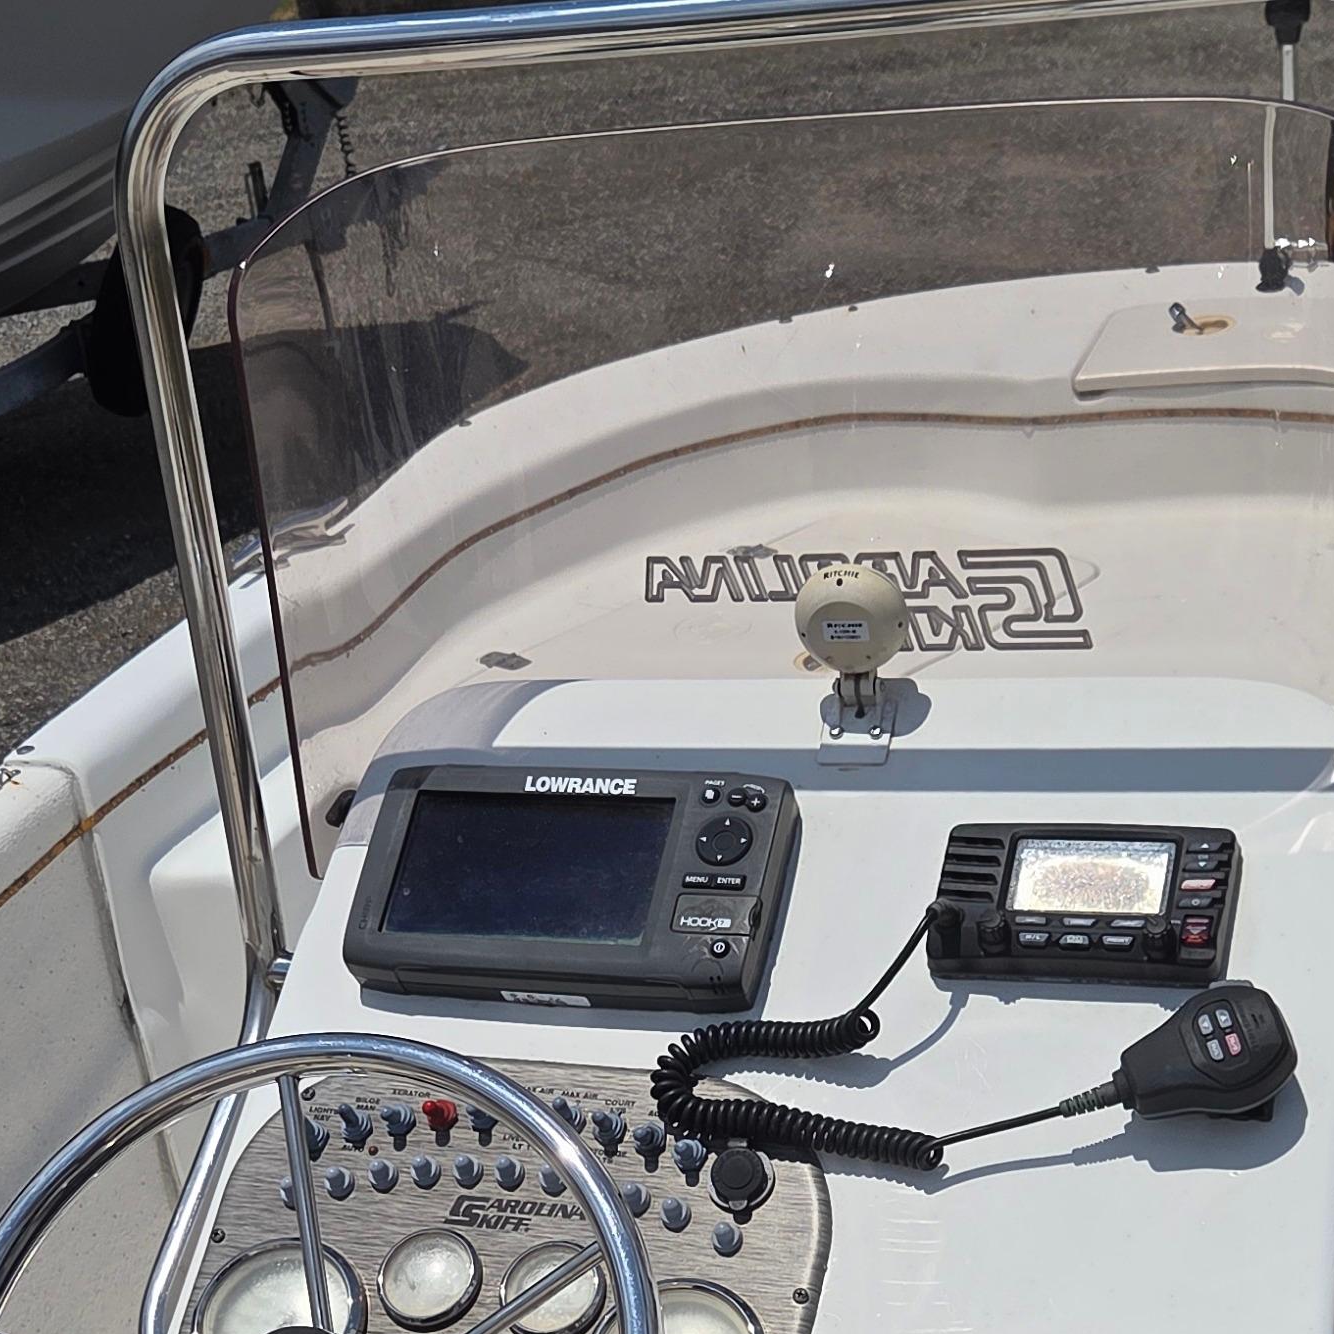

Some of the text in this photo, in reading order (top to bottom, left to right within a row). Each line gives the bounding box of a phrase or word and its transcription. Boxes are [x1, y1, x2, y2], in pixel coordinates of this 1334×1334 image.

[823, 570, 860, 579] RITCHIE
[525, 775, 637, 795] LOWRANCE
[704, 779, 726, 787] PAGES
[685, 875, 709, 883] MENU
[717, 876, 741, 885] ENTER
[605, 1099, 637, 1107] COURT
[449, 1195, 586, 1220] CAROLINA
[443, 1204, 532, 1232] SKIFF
